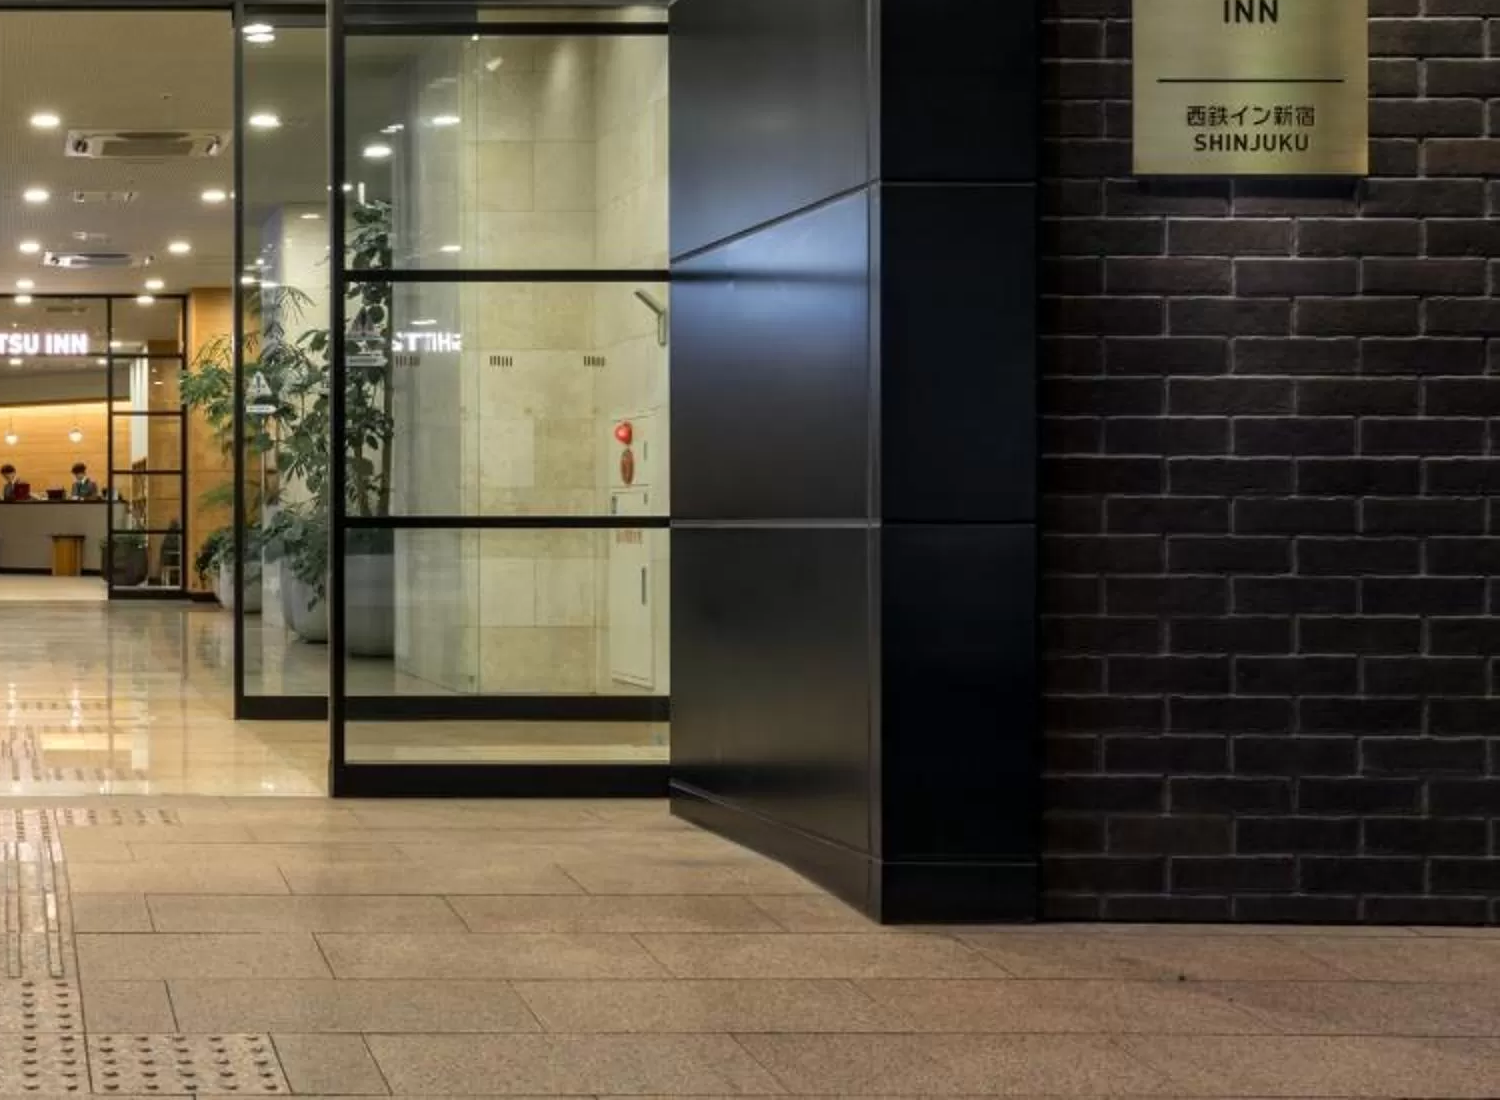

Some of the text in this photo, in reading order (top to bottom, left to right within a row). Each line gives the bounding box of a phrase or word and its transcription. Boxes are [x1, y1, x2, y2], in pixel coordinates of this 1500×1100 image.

[1187, 104, 1316, 127] 西鉄イン新宿
[1193, 133, 1310, 152] SHINJUKU
[45, 332, 89, 356] INN
